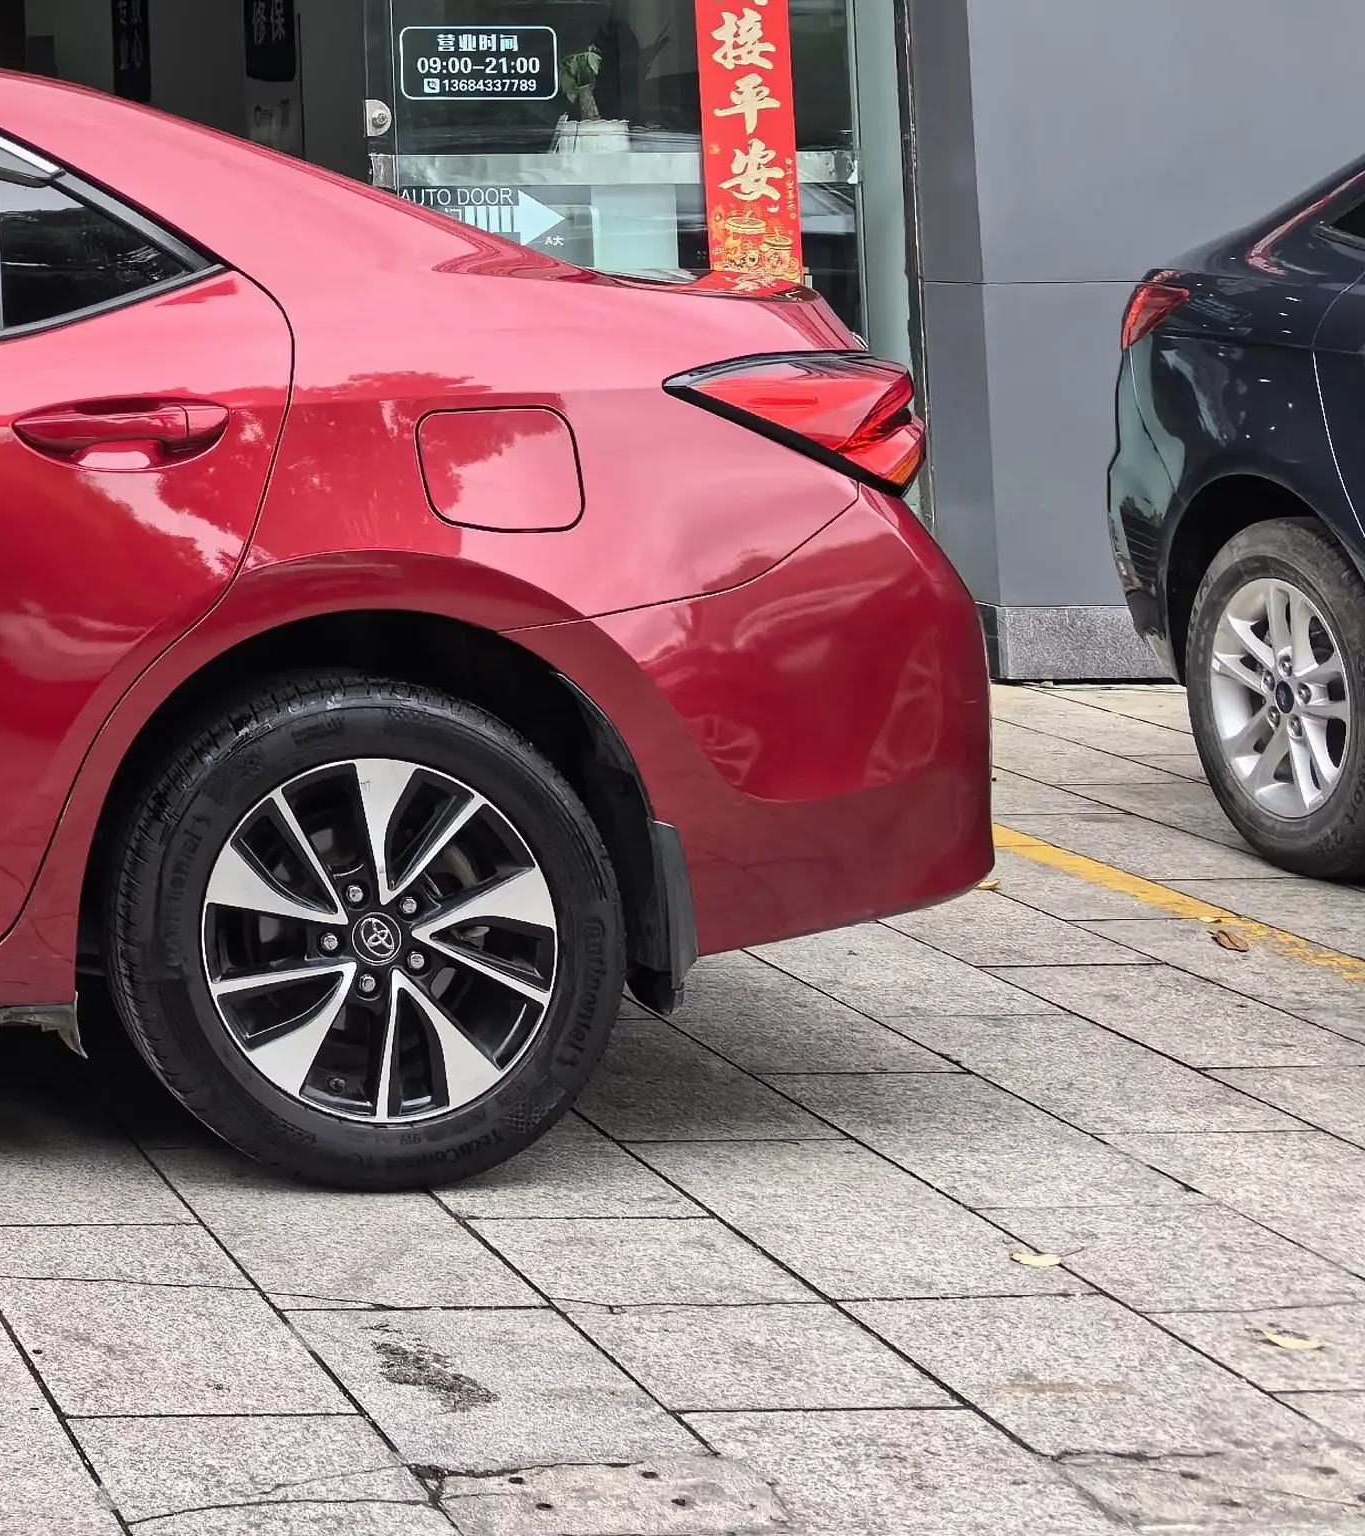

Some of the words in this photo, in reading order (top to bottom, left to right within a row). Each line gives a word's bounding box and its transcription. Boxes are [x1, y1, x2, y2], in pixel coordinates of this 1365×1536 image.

[436, 33, 519, 52] 营业时间
[442, 79, 537, 92] 13684337789
[400, 188, 452, 206] AUTO
[457, 188, 513, 206] DOOR
